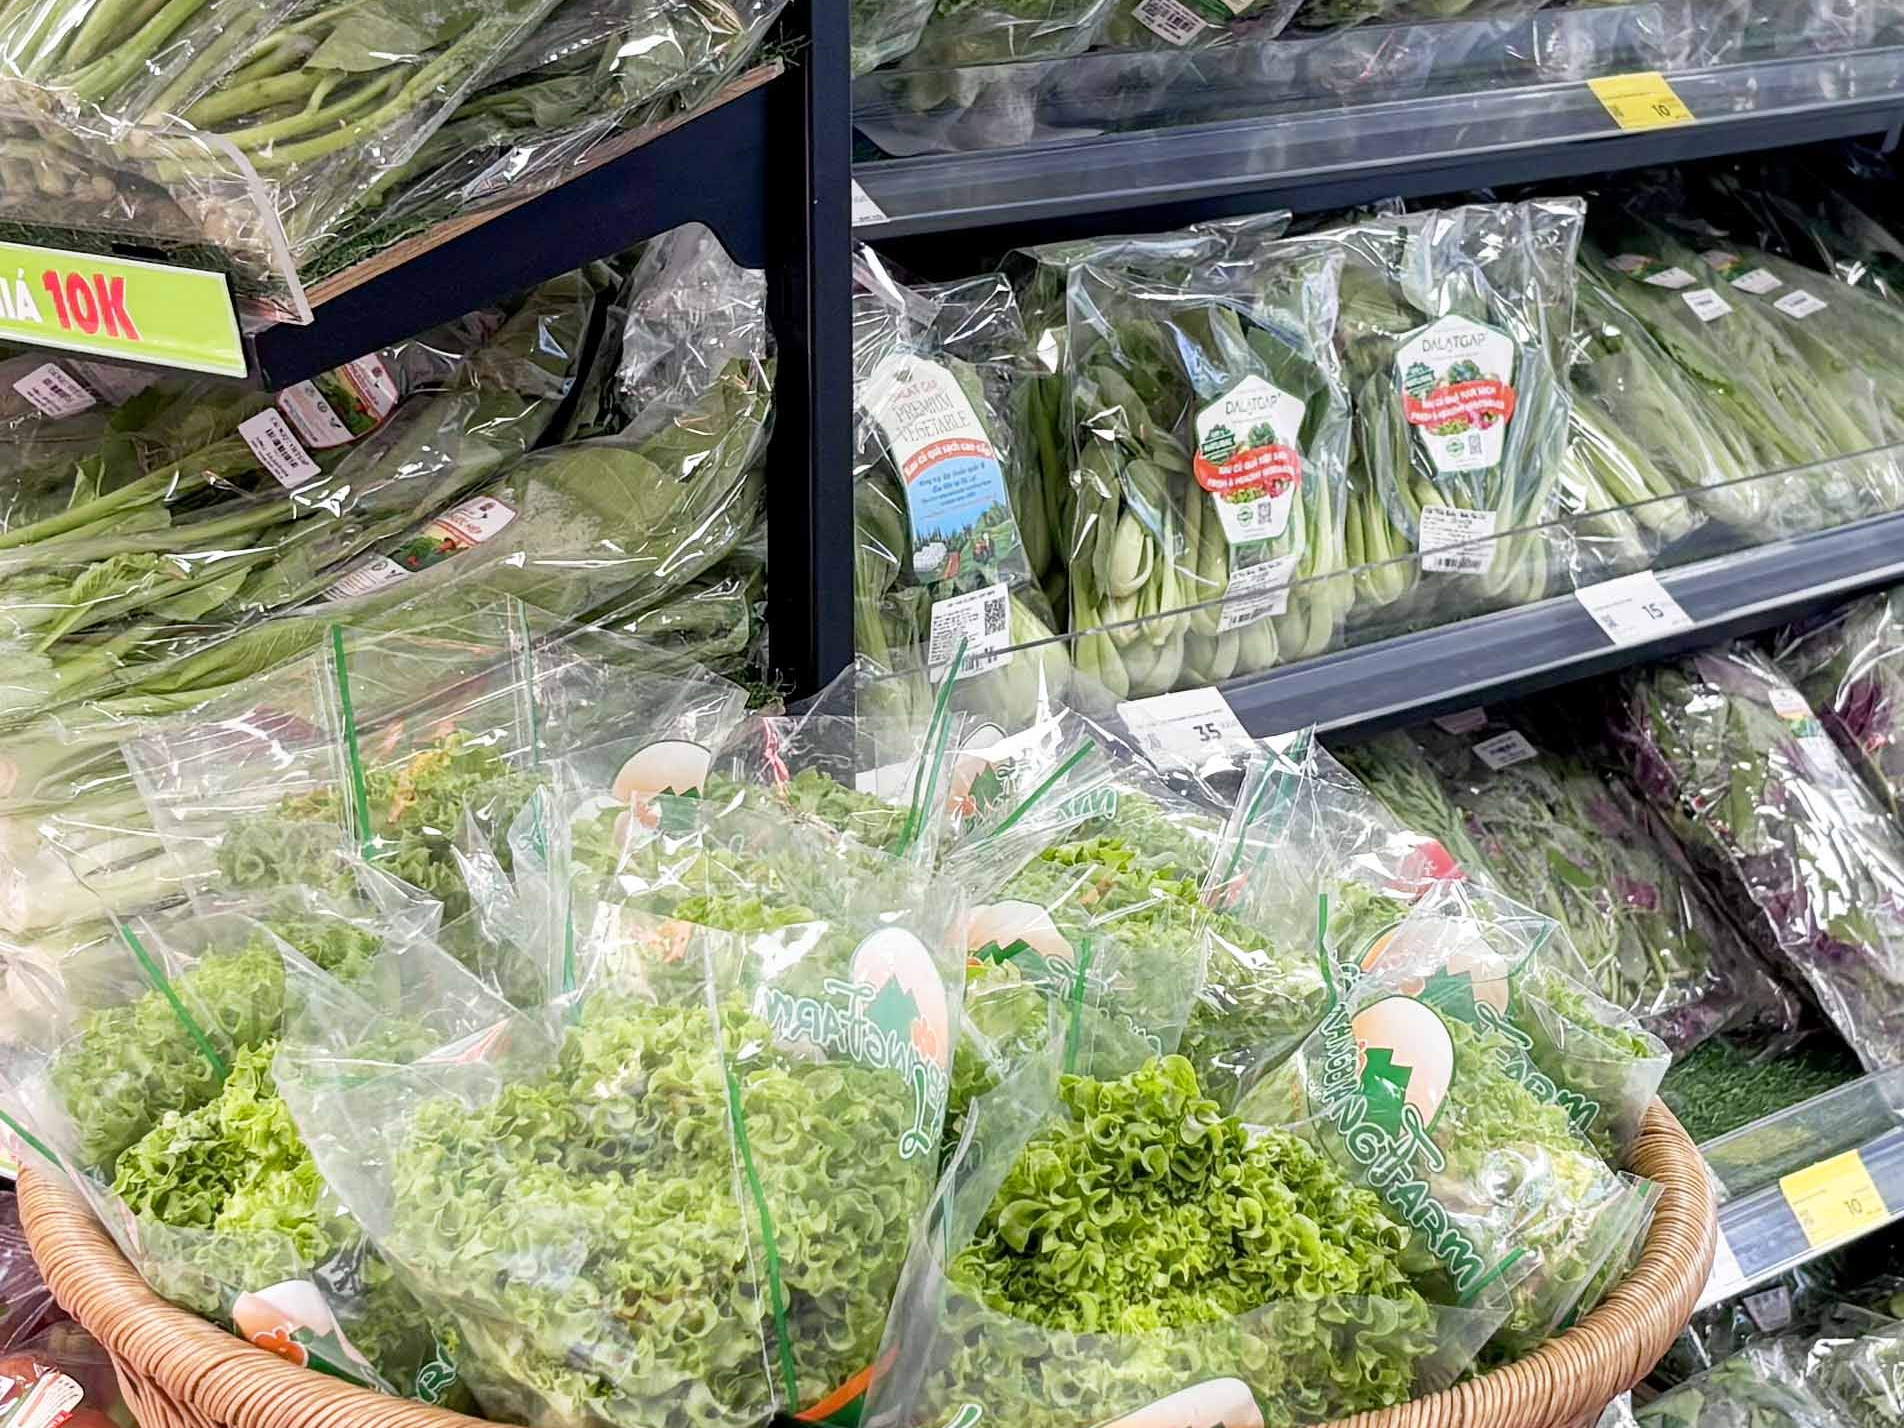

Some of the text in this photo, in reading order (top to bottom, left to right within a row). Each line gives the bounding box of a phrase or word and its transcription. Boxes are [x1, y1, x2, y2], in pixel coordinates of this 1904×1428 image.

[1652, 103, 1670, 119] 10
[41, 269, 142, 342] 10K
[1641, 601, 1665, 620] 15
[1193, 722, 1223, 743] 35
